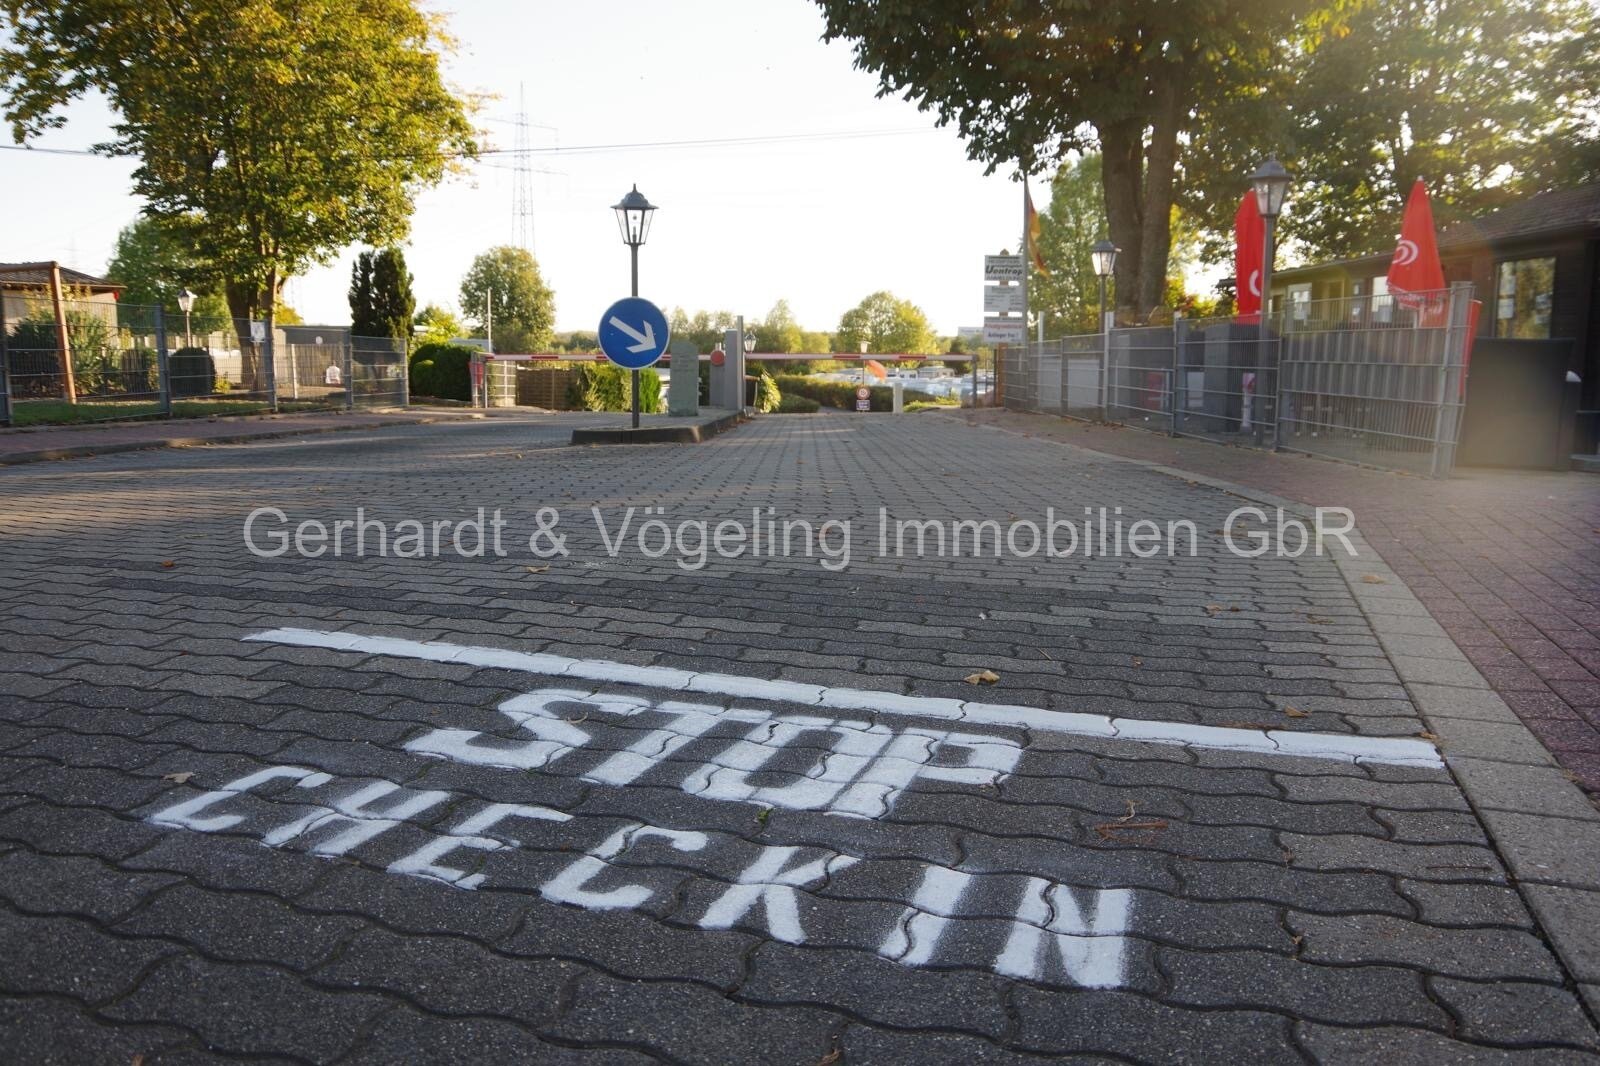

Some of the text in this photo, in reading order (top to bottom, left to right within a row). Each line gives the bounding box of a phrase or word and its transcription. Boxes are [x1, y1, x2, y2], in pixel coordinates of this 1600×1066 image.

[403, 688, 1023, 820] STOP
[147, 766, 1134, 990] CHECK IN
